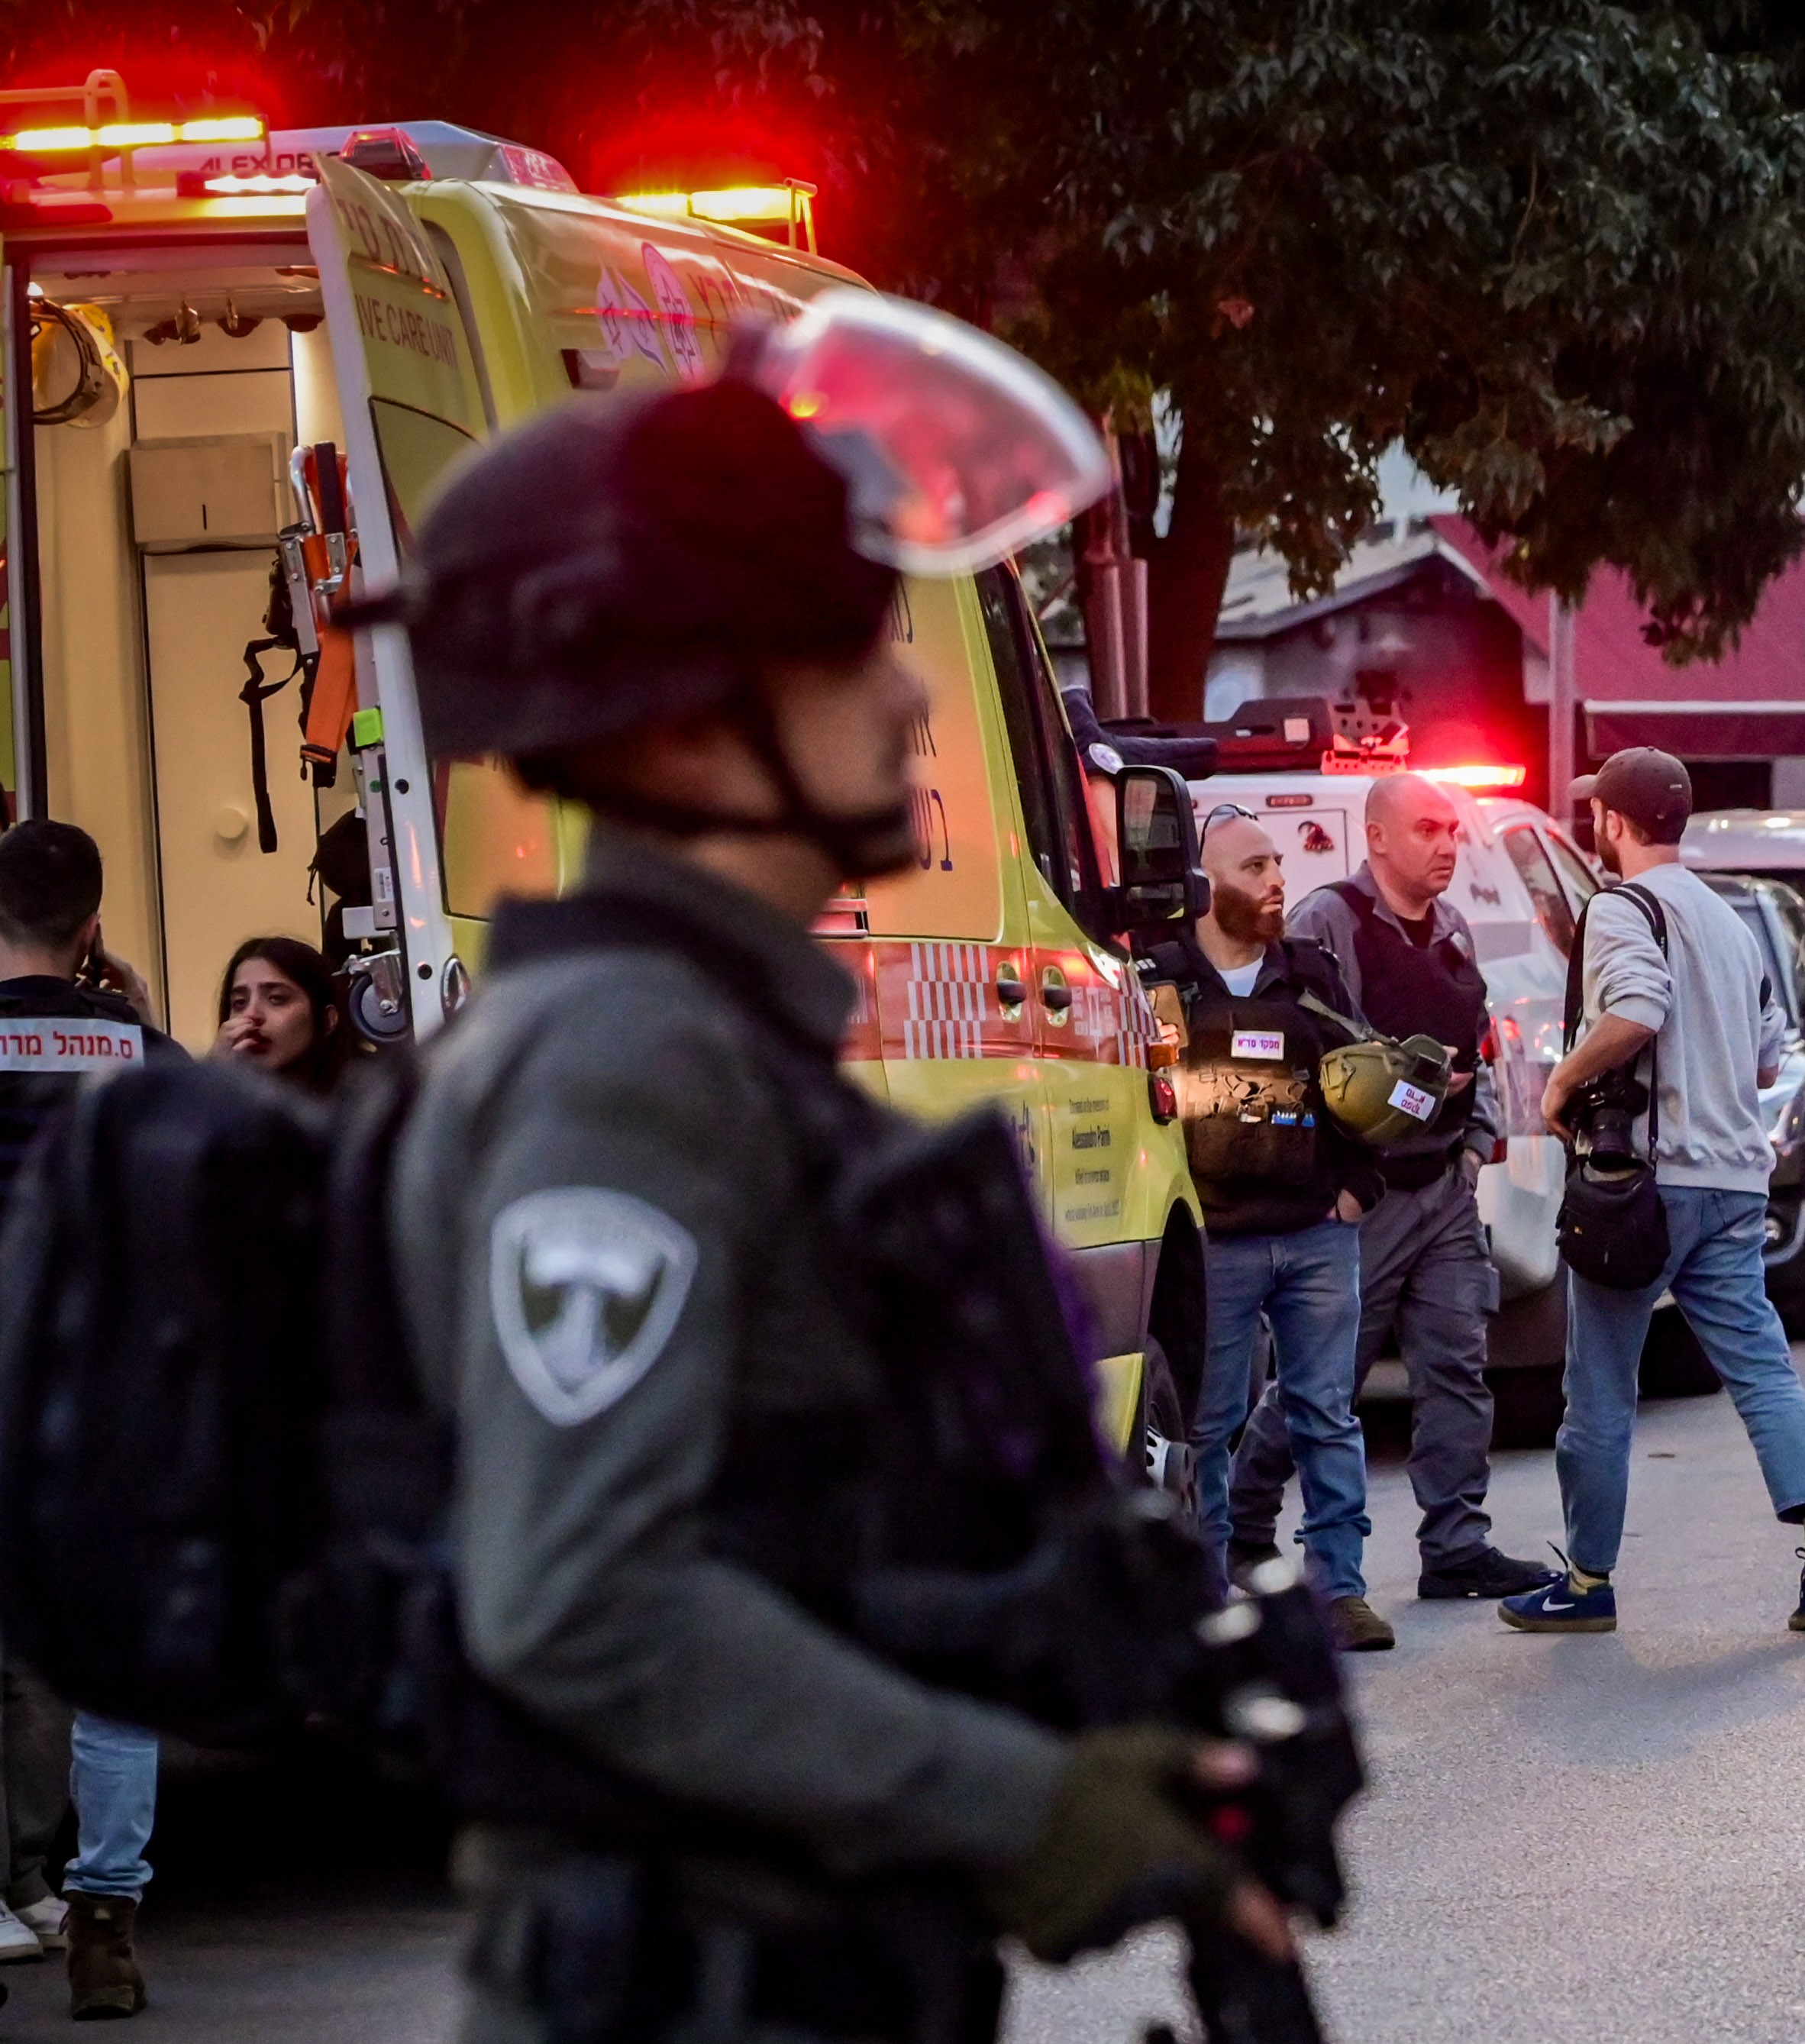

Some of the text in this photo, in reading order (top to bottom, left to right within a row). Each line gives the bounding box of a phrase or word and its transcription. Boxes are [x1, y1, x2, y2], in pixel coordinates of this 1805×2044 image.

[386, 303, 430, 357] CARE
[425, 316, 459, 369] UNIT
[53, 1031, 133, 1059] ס.מנהל
